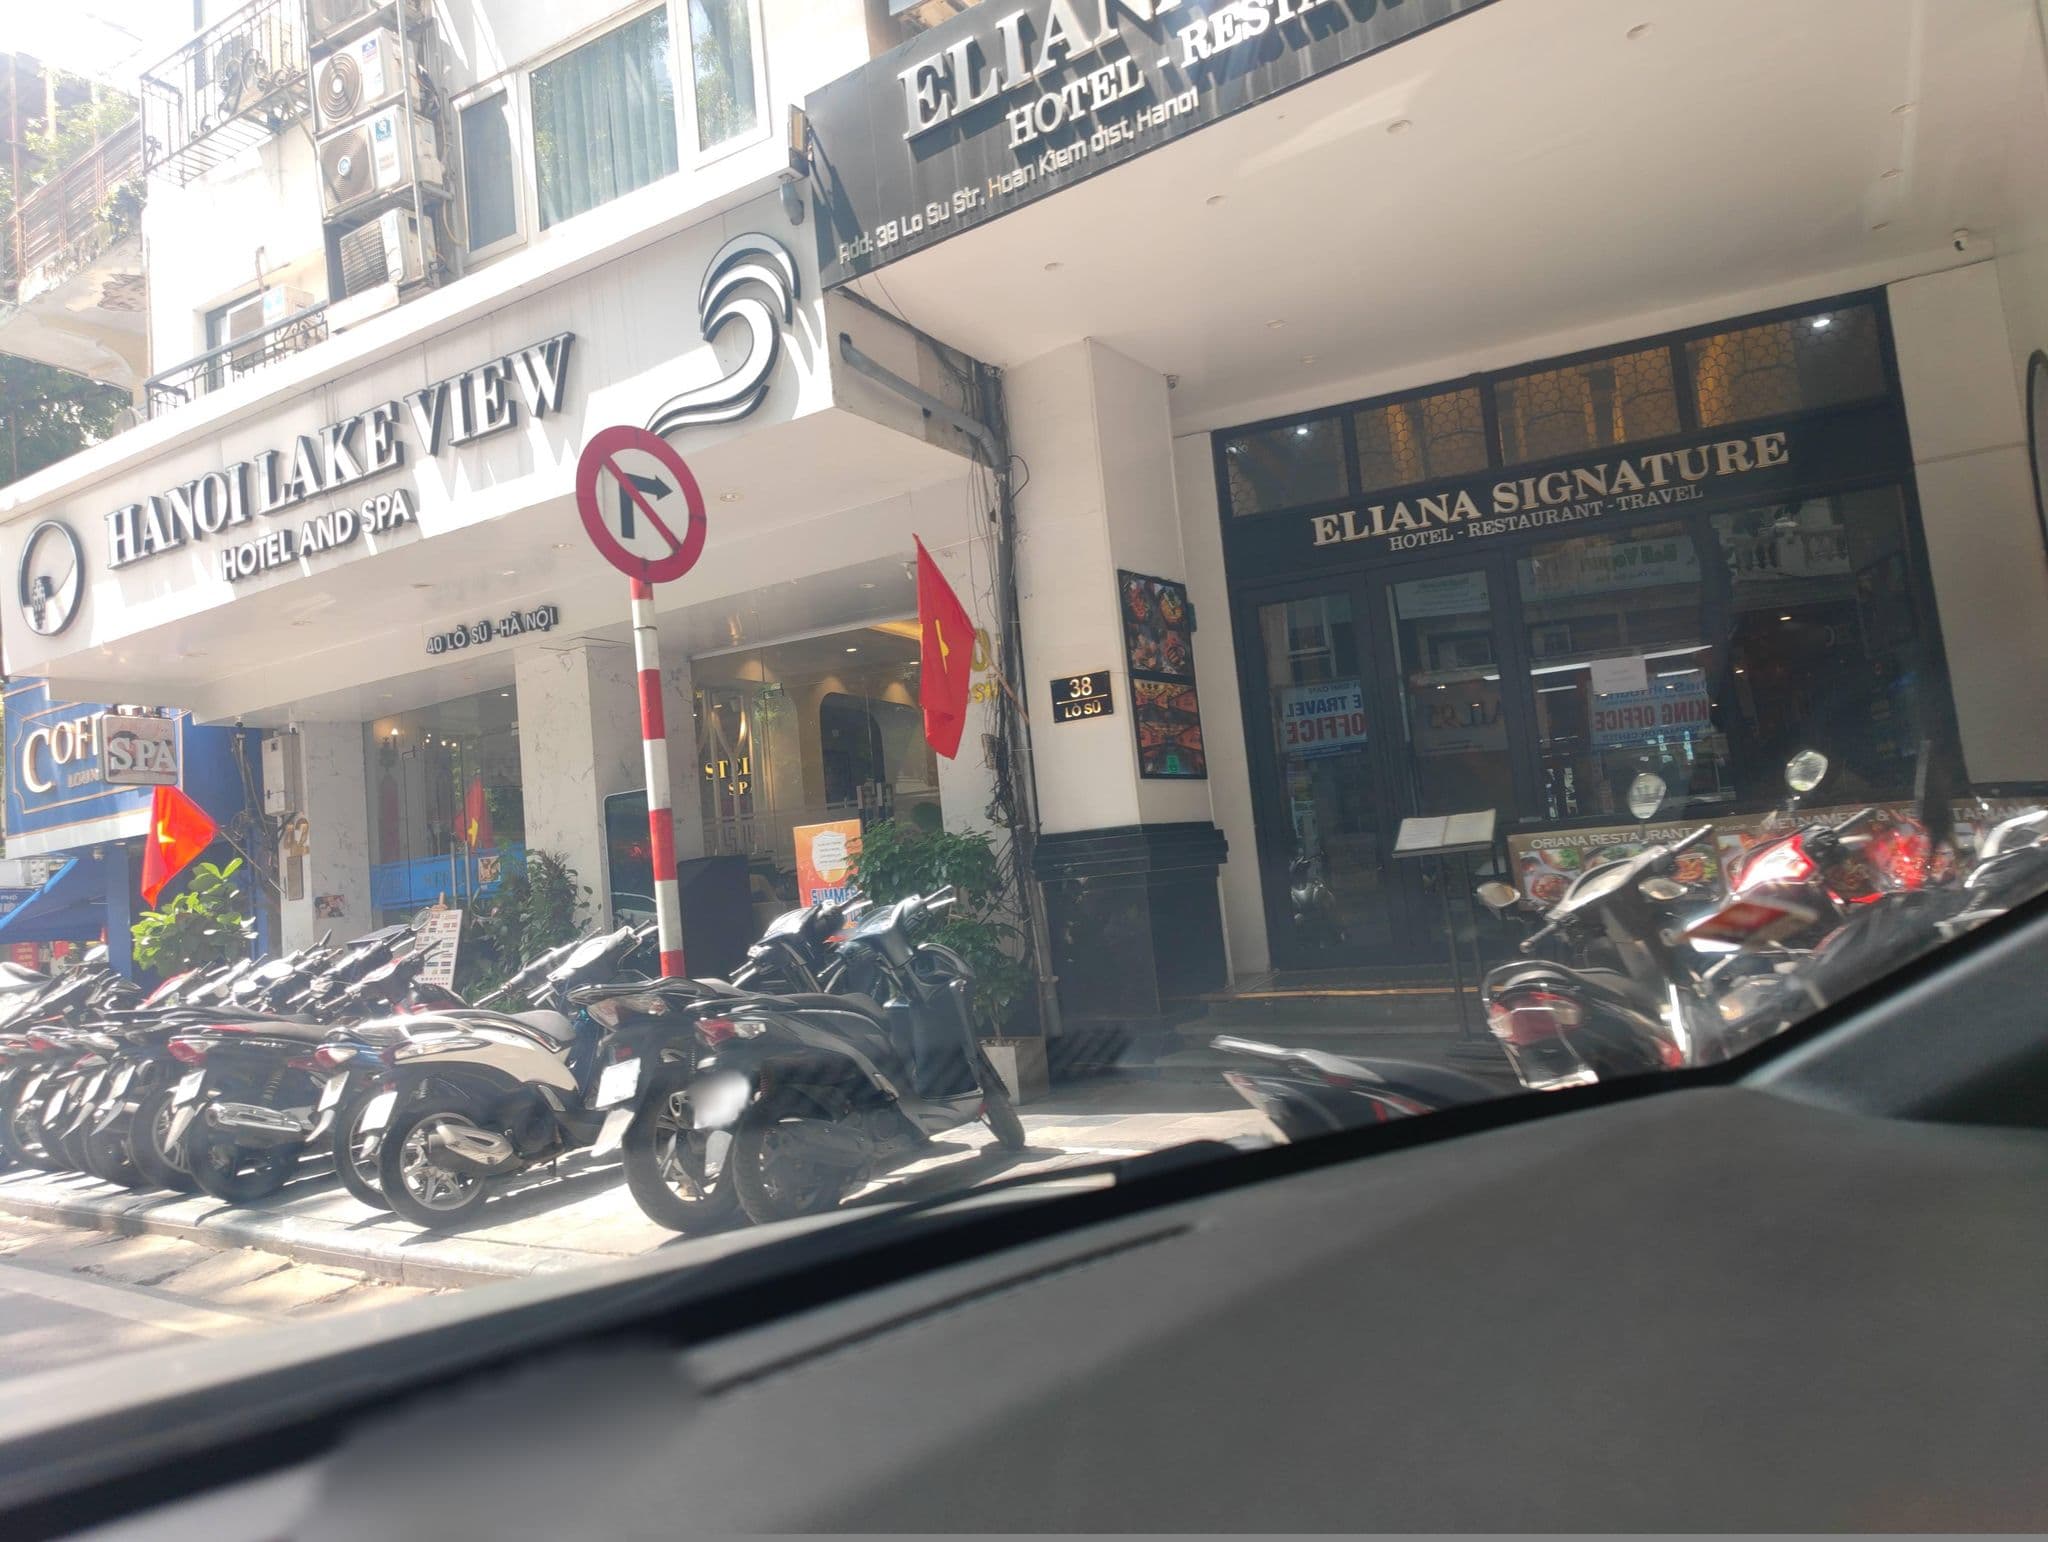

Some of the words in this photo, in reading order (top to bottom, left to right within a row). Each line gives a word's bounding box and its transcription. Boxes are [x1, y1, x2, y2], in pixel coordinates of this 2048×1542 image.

[1005, 56, 1145, 149] HOTEL
[839, 231, 874, 265] Add:
[875, 220, 899, 248] 38
[901, 213, 924, 237] Lo
[926, 201, 951, 226] Su
[988, 162, 1037, 198] Hoan
[1038, 138, 1087, 176] Kiem
[1090, 117, 1135, 152] dist,
[1136, 85, 1200, 132] Hanoi
[104, 461, 251, 570] HANOI
[254, 400, 405, 517] LAKE
[403, 331, 576, 458] VIEW
[1311, 489, 1482, 547] ELIANA
[1492, 431, 1790, 514] SIGNATURE
[220, 528, 292, 583] HOTEL
[297, 506, 361, 558] AND
[360, 487, 418, 535] SPA
[1389, 527, 1454, 551] HOTEL
[1467, 500, 1604, 537] RESTAURANT
[1616, 484, 1704, 511] TRAVEL
[426, 636, 447, 654] 40
[1069, 676, 1093, 698] 38
[109, 736, 177, 772] SPA
[1531, 835, 1592, 850] ORIANA
